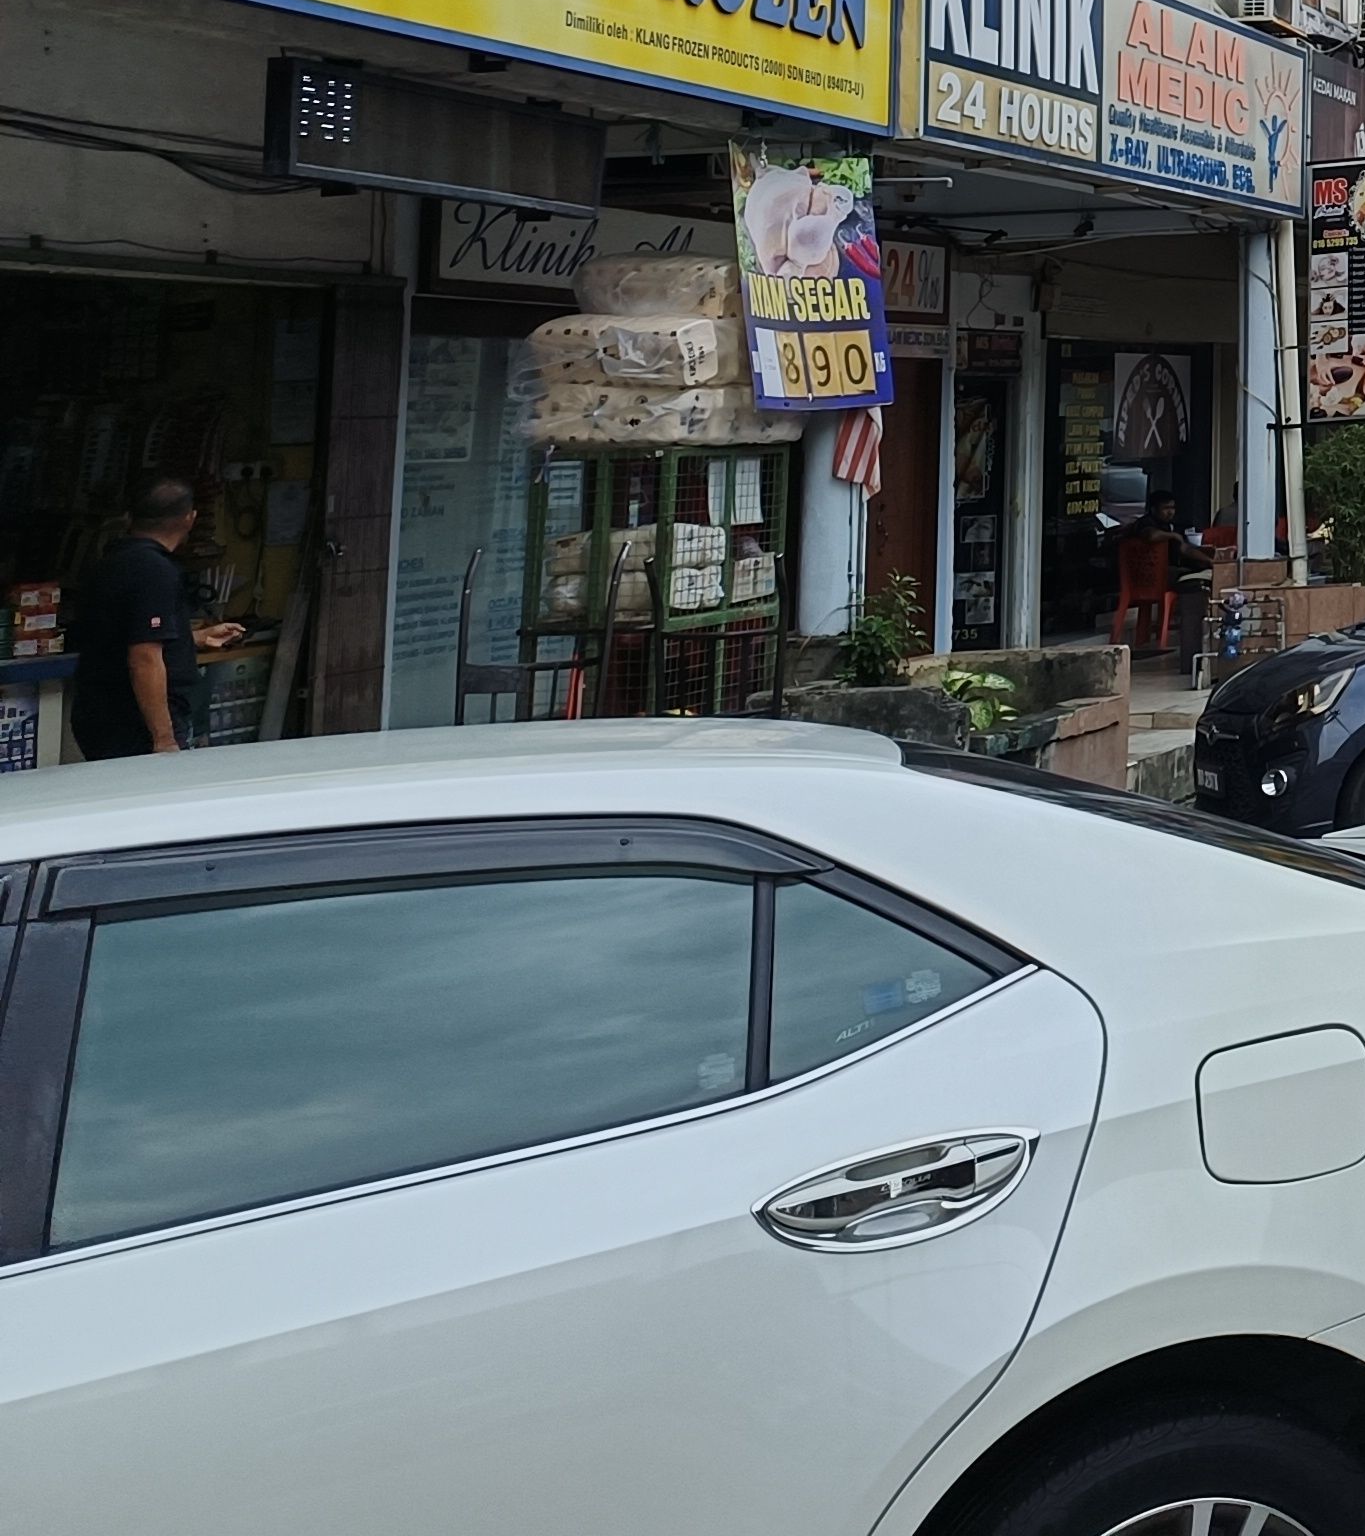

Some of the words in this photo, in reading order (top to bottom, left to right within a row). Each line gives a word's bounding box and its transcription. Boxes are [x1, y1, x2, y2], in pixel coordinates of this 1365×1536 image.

[565, 10, 605, 36] Dimiliki
[606, 23, 629, 41] oleh
[635, 27, 670, 51] KLANG
[671, 36, 711, 61] FROZEN
[711, 46, 760, 72] PRODUCTS
[760, 57, 786, 82] (2000)
[787, 63, 804, 83] SDN
[805, 67, 822, 88] BHD
[1126, 0, 1245, 84] ALAM
[936, 71, 987, 130] 24
[998, 85, 1095, 155] HOURS
[1118, 51, 1249, 136] MEDIC
[1313, 78, 1333, 98] KEDAI
[1333, 83, 1357, 107] MAKAN
[1313, 177, 1348, 207] MS
[748, 271, 791, 321] AYAM
[790, 276, 871, 323] SEGAR
[886, 248, 916, 307] 24
